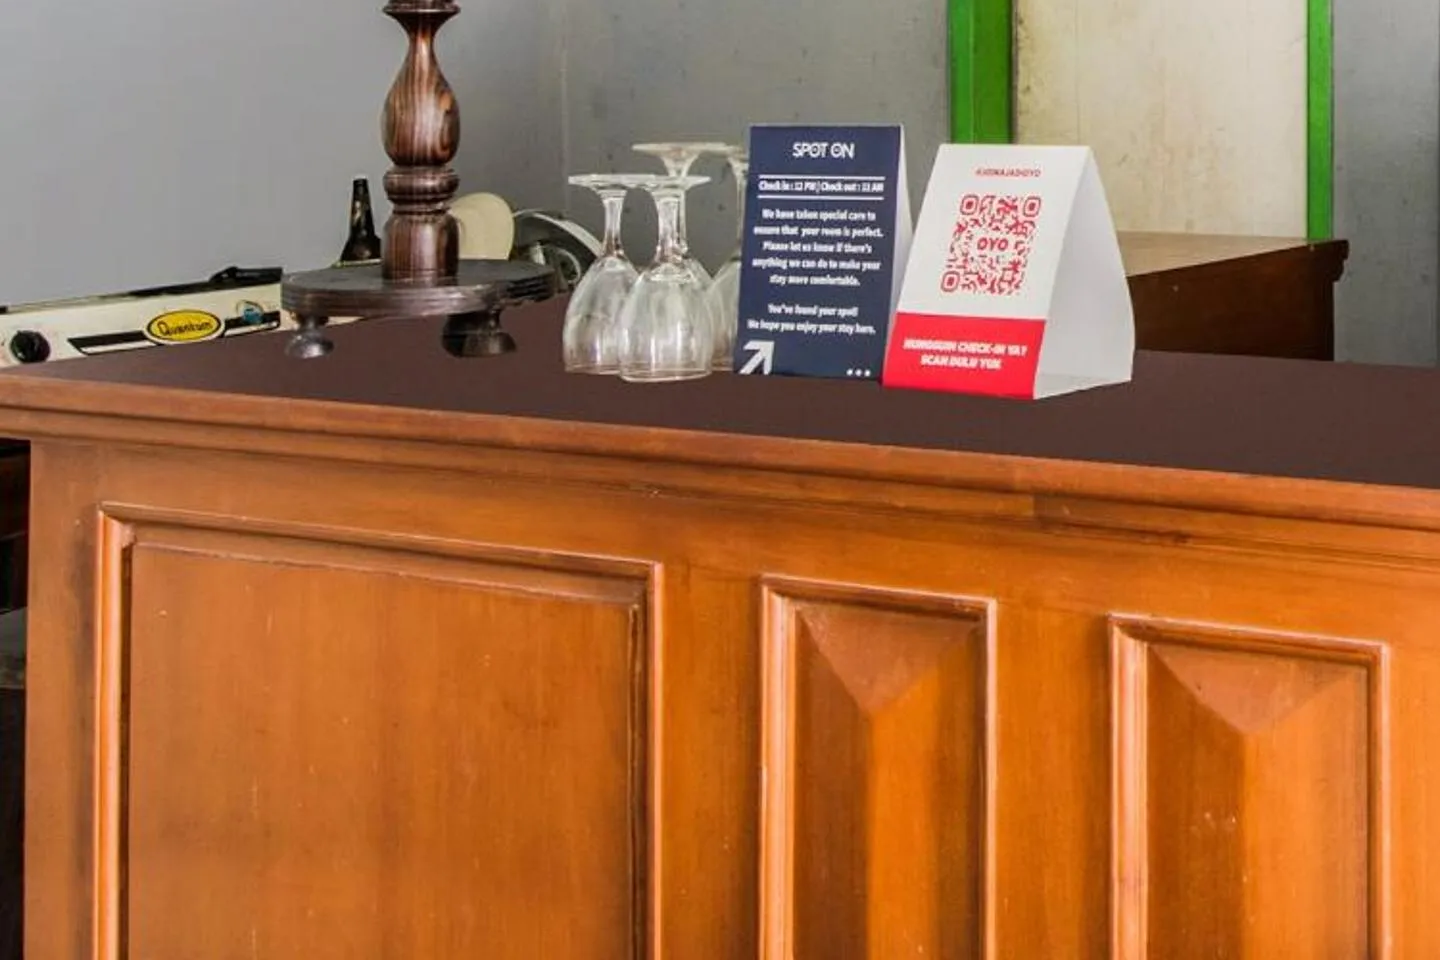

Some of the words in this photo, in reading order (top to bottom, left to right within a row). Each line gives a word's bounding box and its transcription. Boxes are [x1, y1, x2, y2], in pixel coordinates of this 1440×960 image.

[792, 141, 829, 158] SPOT
[830, 142, 855, 159] ON
[821, 182, 842, 191] Check
[871, 183, 884, 193] AM
[762, 208, 774, 219] We
[775, 208, 794, 219] have
[796, 209, 818, 220] taken
[820, 209, 847, 222] special
[848, 211, 866, 221] care
[867, 211, 876, 221] to
[781, 225, 799, 235] that
[801, 227, 820, 238] your
[821, 227, 841, 236] room
[852, 226, 884, 238] perfect.
[763, 240, 788, 251] Please
[790, 241, 801, 251] let
[813, 242, 834, 253] know
[844, 243, 872, 253] there's
[977, 237, 1008, 251] OYO
[752, 257, 788, 270] anything
[789, 260, 800, 268] we
[802, 260, 817, 269] can
[818, 258, 828, 269] do
[829, 259, 837, 269] to
[839, 259, 861, 270] make
[862, 261, 881, 272] your
[769, 274, 787, 286] stay
[788, 275, 809, 285] more
[767, 303, 794, 314] You've
[795, 304, 818, 316] found
[818, 307, 838, 317] your
[747, 319, 760, 329] We
[760, 319, 779, 331] hope
[780, 322, 795, 332] you
[796, 321, 819, 334] enjoy
[819, 323, 838, 334] your
[838, 324, 855, 335] stay
[958, 341, 1006, 355] CHECK-IN
[921, 354, 948, 366] SCAN
